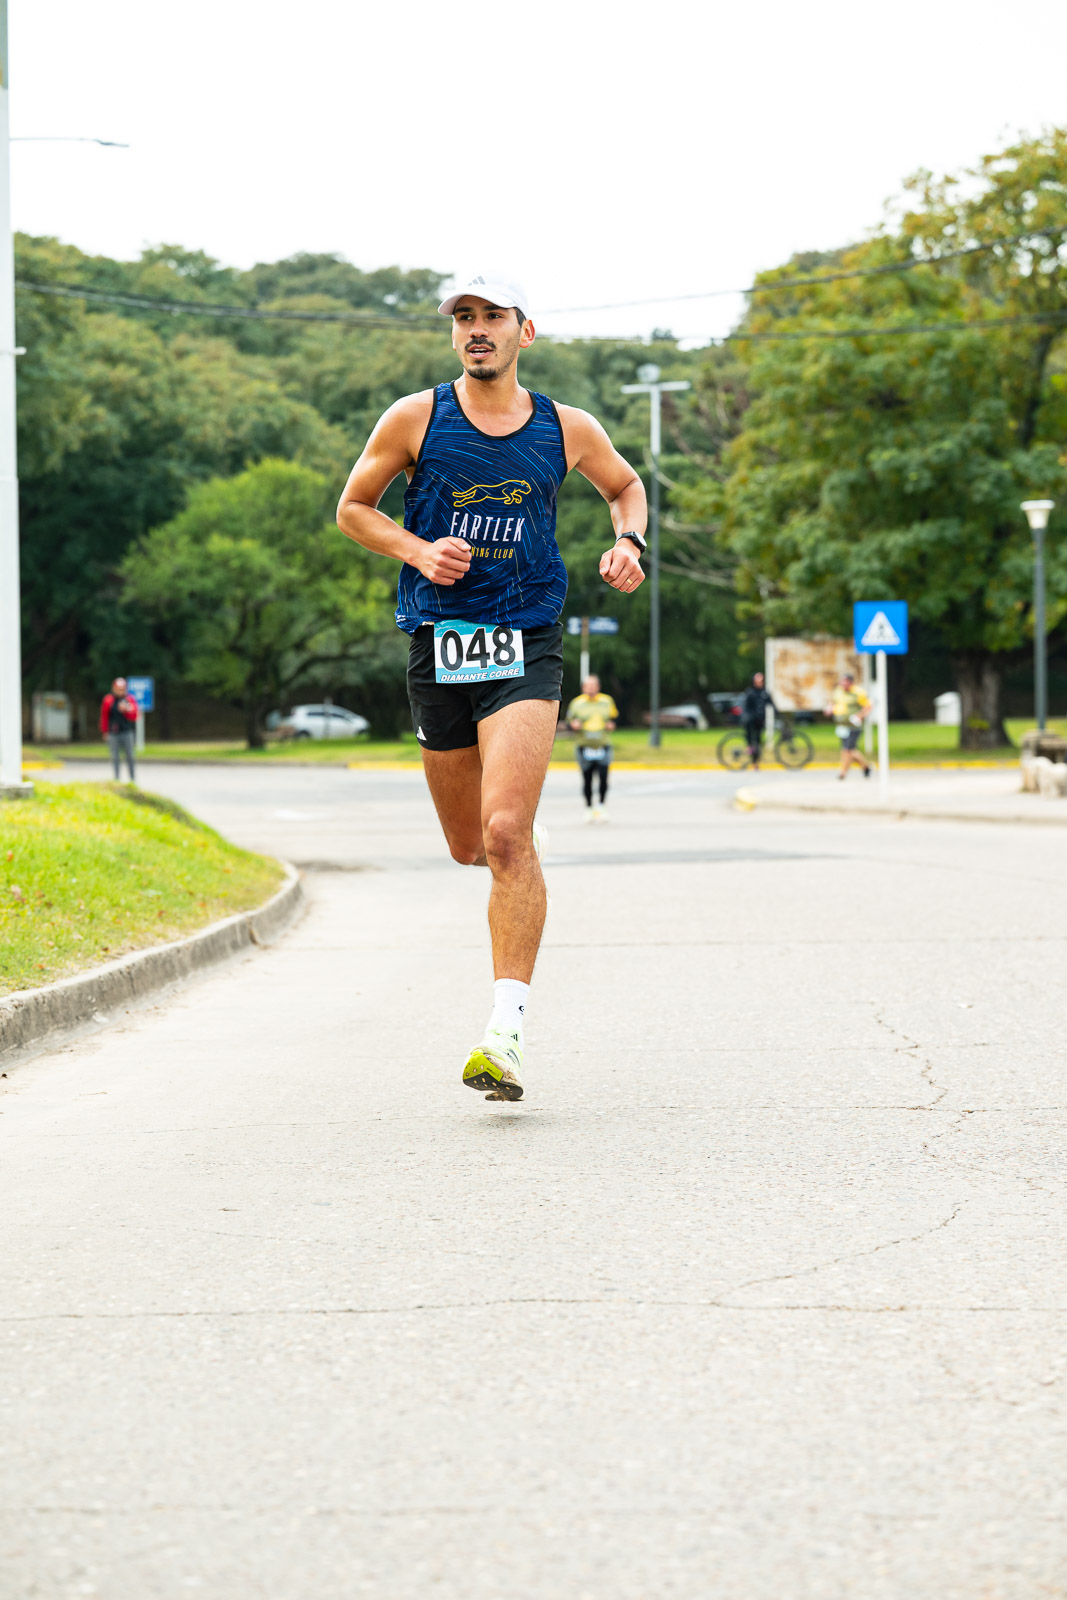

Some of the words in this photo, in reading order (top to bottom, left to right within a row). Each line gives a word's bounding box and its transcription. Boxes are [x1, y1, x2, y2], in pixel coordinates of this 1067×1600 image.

[450, 511, 525, 542] FARTLEK
[471, 546, 490, 558] NING
[493, 548, 514, 559] CLUB
[441, 626, 516, 671] 048
[440, 672, 488, 682] DIAMANTE
[489, 667, 520, 679] CORRE
